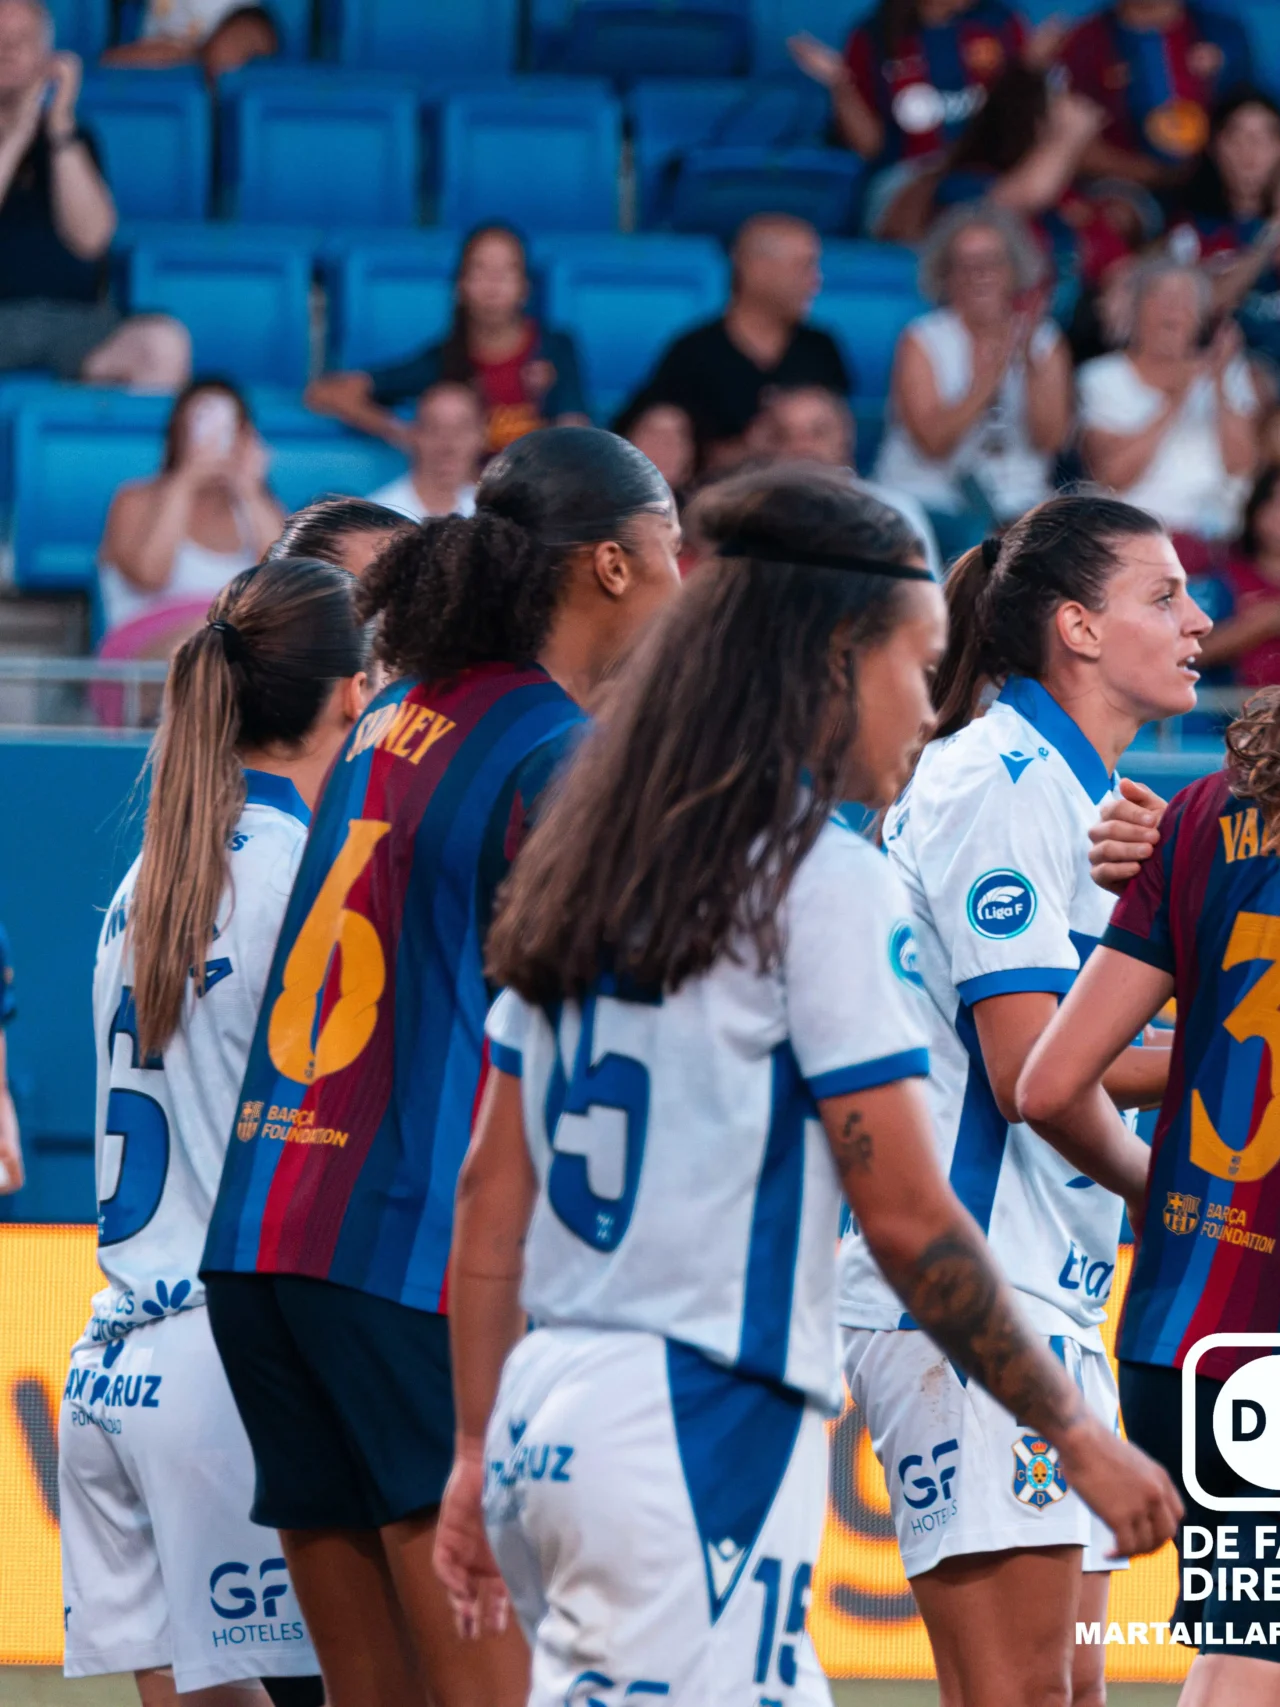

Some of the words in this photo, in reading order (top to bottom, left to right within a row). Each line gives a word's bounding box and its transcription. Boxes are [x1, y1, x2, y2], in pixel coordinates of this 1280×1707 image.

[985, 906, 1013, 920] Liga
[1015, 903, 1023, 915] F
[267, 819, 392, 1086] 6
[261, 1123, 349, 1148] FOUNDATION
[1206, 1203, 1248, 1227] BARÇA
[1200, 1221, 1277, 1254] FOUNDATION
[898, 1438, 959, 1510] GF
[209, 1557, 288, 1620] GF
[212, 1622, 304, 1648] HOTELES
